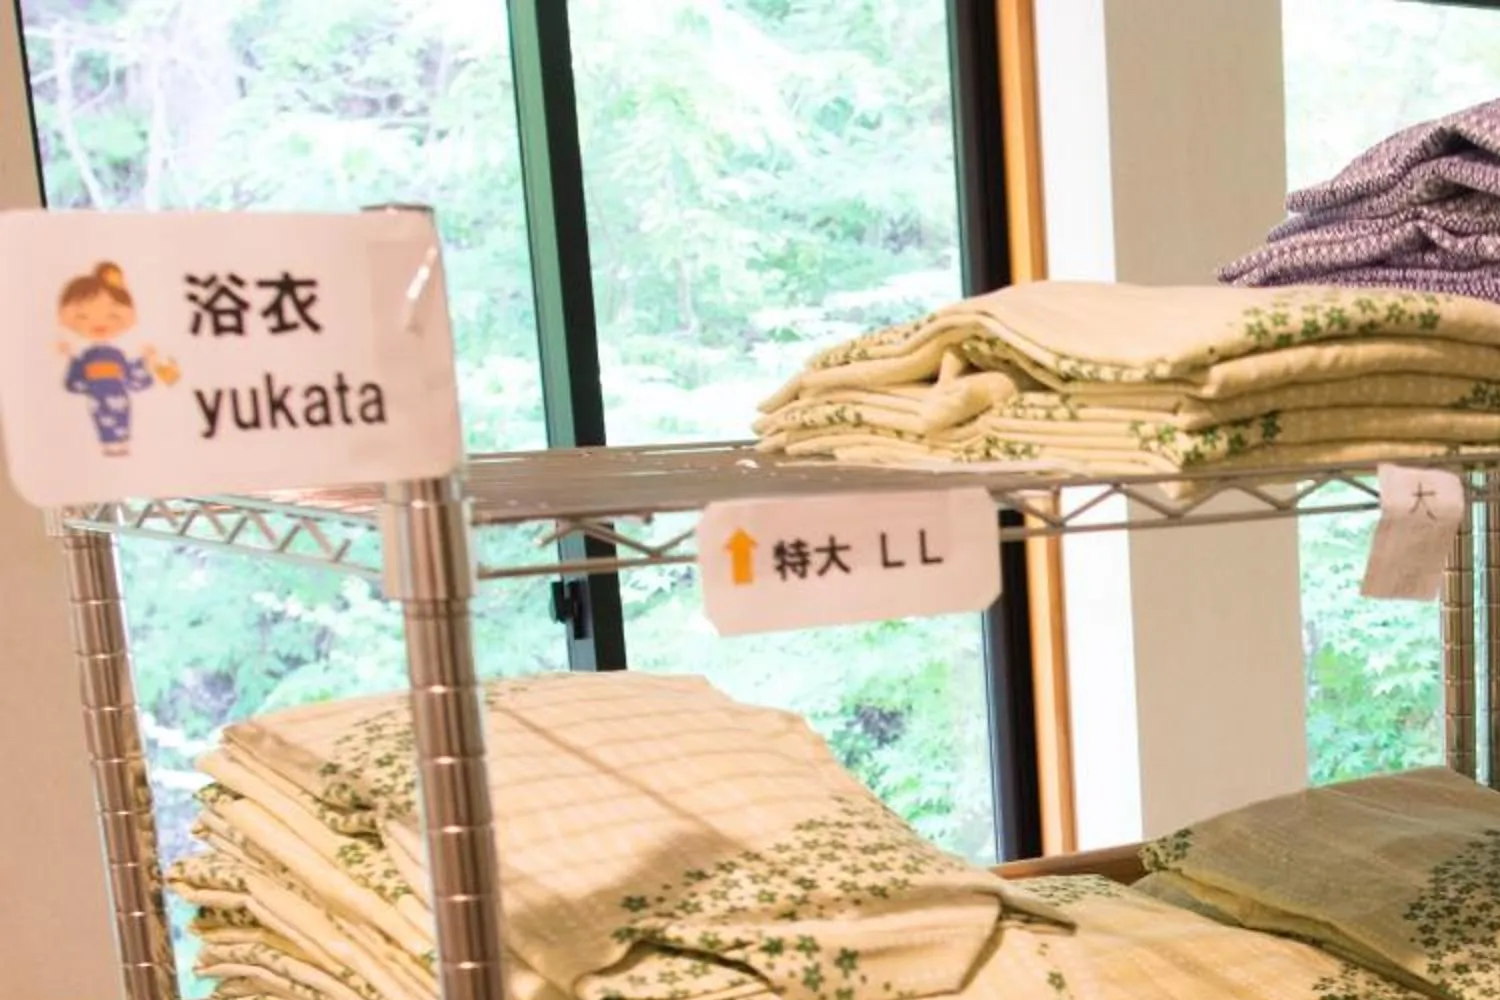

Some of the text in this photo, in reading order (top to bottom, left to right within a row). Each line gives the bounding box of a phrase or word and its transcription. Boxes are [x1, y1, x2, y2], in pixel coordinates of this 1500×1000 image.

[184, 272, 323, 337] 浴衣
[195, 372, 388, 439] yukata
[1409, 481, 1438, 522] 大
[773, 535, 852, 582] 特大
